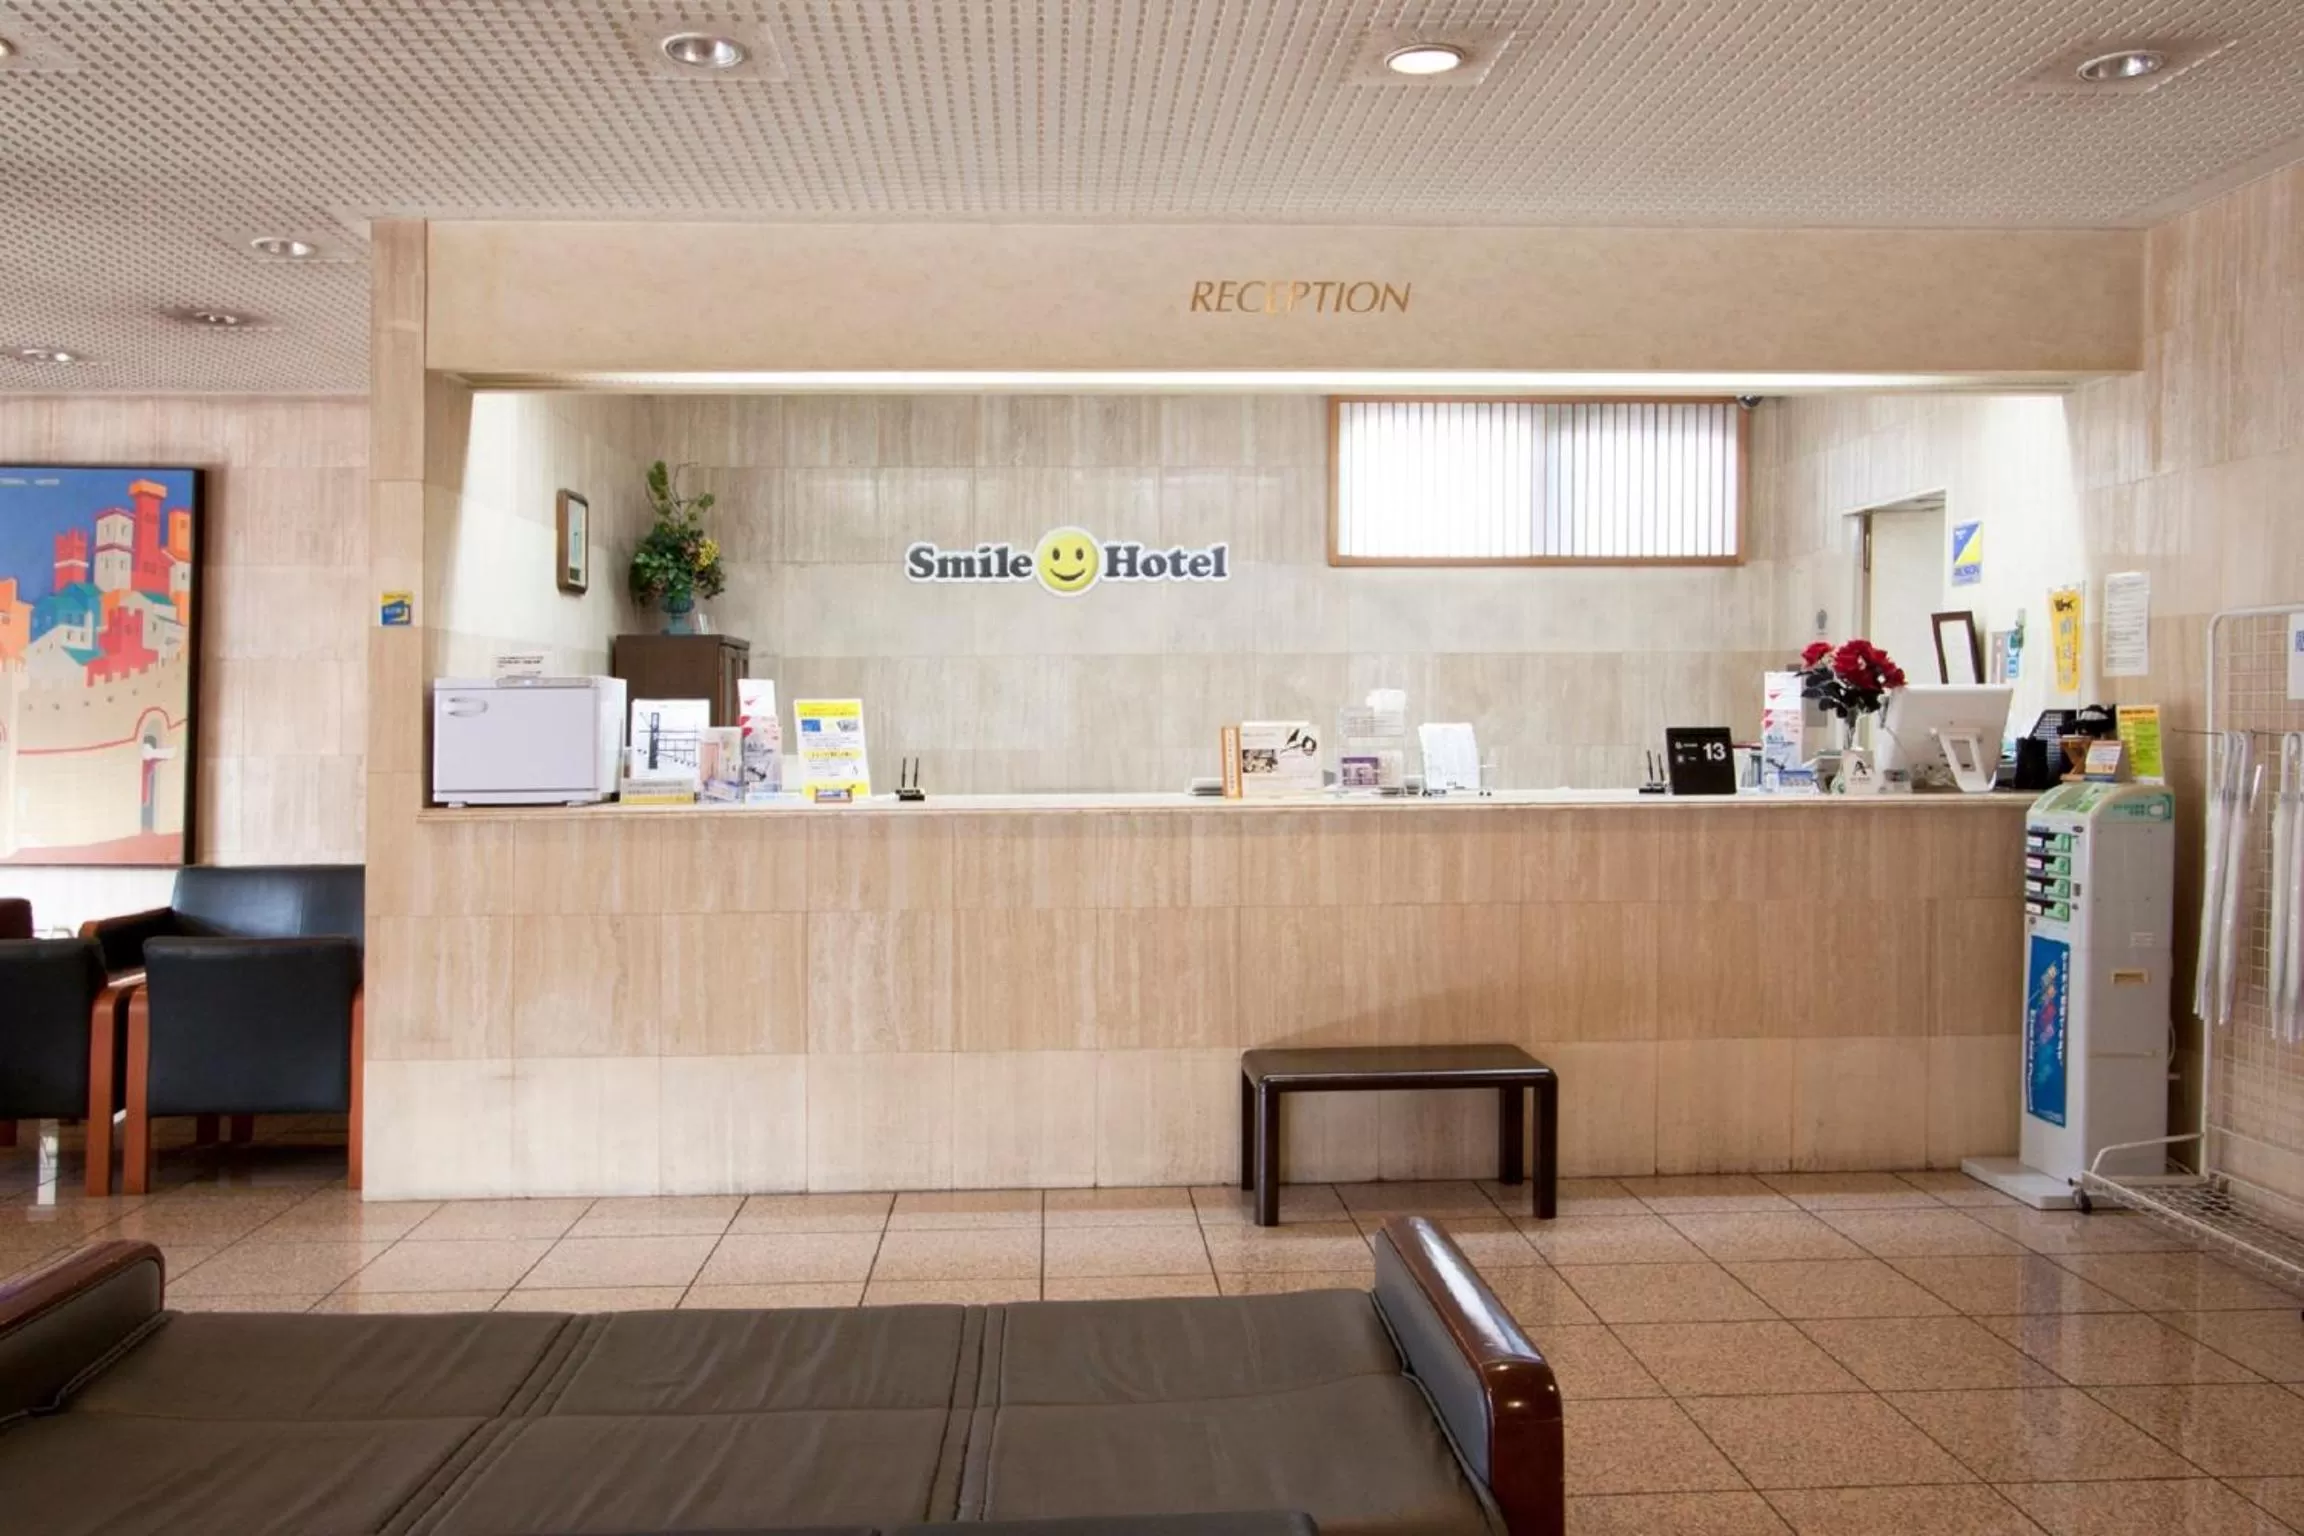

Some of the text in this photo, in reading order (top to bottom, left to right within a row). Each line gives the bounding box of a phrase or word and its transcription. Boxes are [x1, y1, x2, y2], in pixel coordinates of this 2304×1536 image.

[1190, 280, 1412, 313] RECEPTION
[907, 545, 1228, 578] Smile Hotel
[1703, 742, 1726, 761] 13
